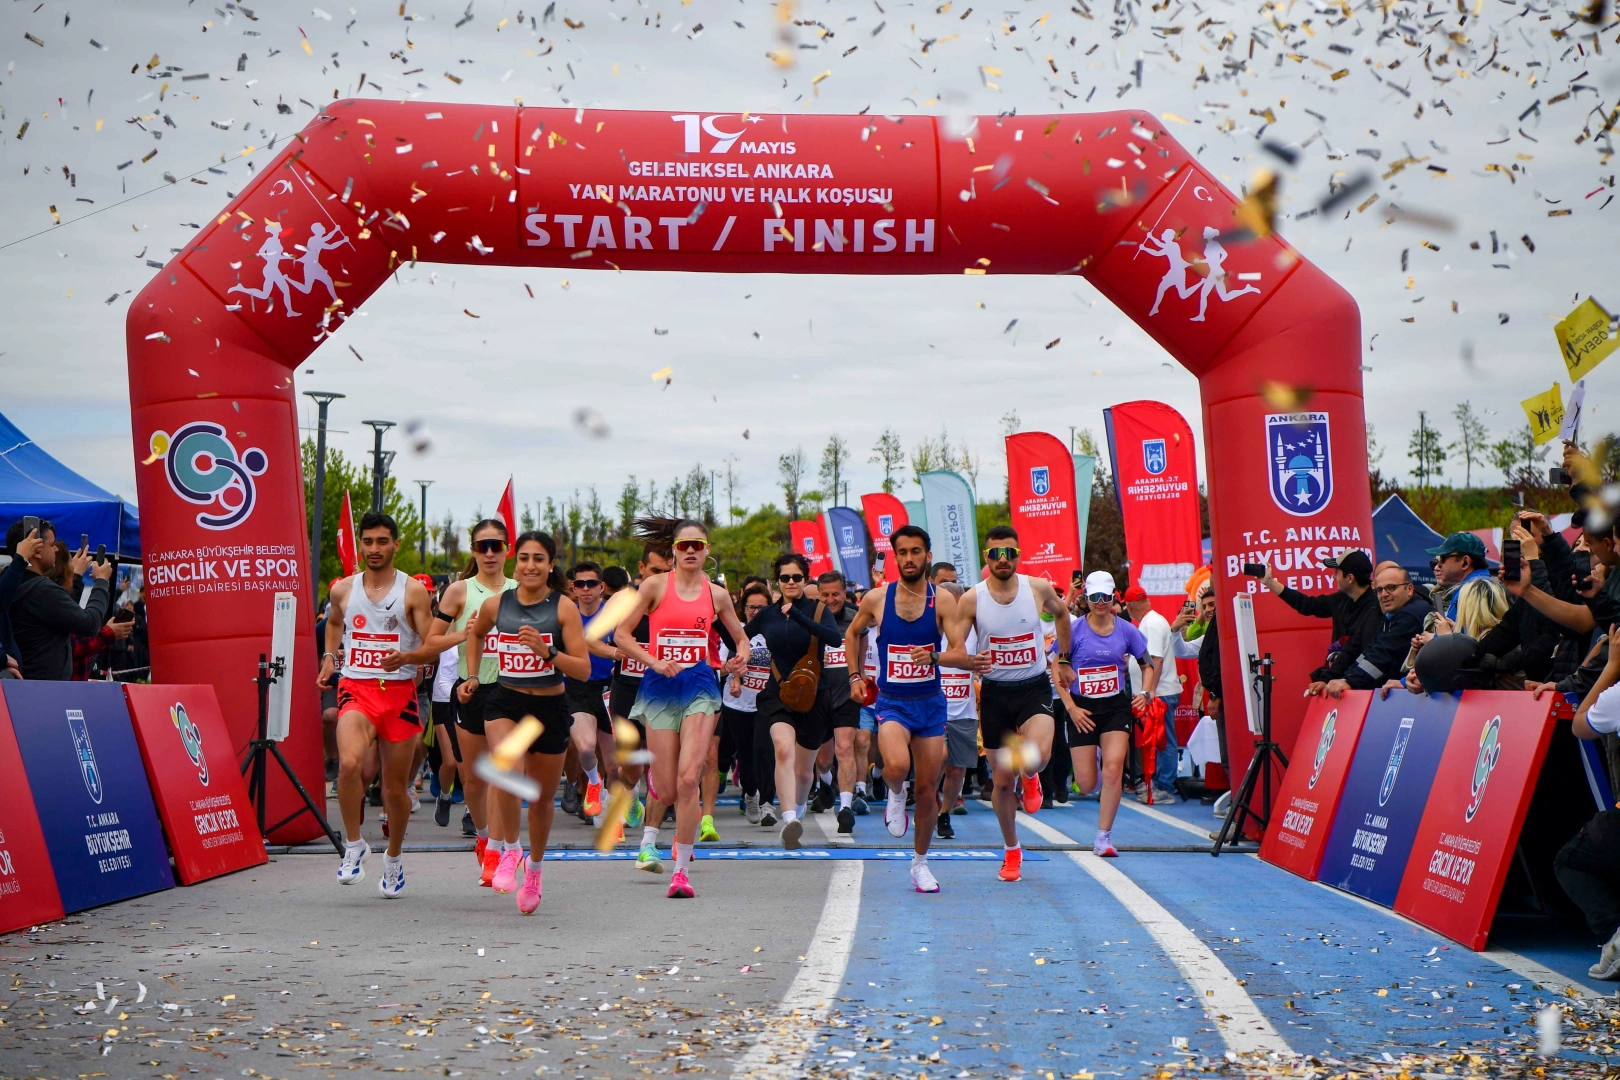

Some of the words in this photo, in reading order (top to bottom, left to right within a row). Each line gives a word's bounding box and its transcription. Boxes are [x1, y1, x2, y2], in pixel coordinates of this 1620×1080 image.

[740, 141, 796, 154] MAYIS
[629, 161, 749, 179] GELENEKSEL
[753, 163, 834, 179] ANKARA
[569, 183, 614, 201] YARI
[619, 185, 726, 203] MARATONU
[730, 187, 755, 203] VE
[761, 187, 810, 204] HALK
[817, 187, 893, 206] KOŞUSU
[525, 213, 688, 251] START
[712, 215, 737, 251] /
[763, 218, 935, 253] FINISH
[1269, 413, 1326, 423] ANKARA
[1243, 532, 1277, 546] T.C.
[1286, 527, 1361, 542] ANKARA
[160, 549, 194, 561] ANKARA
[197, 545, 254, 558] BÜYÜKŞEHİR
[256, 543, 296, 555] BELEDİYESİ
[148, 557, 220, 586] GENÇLİK
[223, 560, 249, 578] VE
[256, 558, 298, 578] SPOR
[151, 581, 196, 598] HİZMETLERİ
[198, 580, 241, 593] DAİRESİ
[244, 580, 300, 592] BAŞKANLIĞI
[355, 651, 389, 667] 503
[663, 646, 700, 662] 5561
[995, 650, 1032, 664] 5040
[504, 654, 545, 671] 5027
[893, 663, 930, 677] 5029
[1085, 680, 1115, 694] 5739
[98, 811, 120, 826] ANKARA
